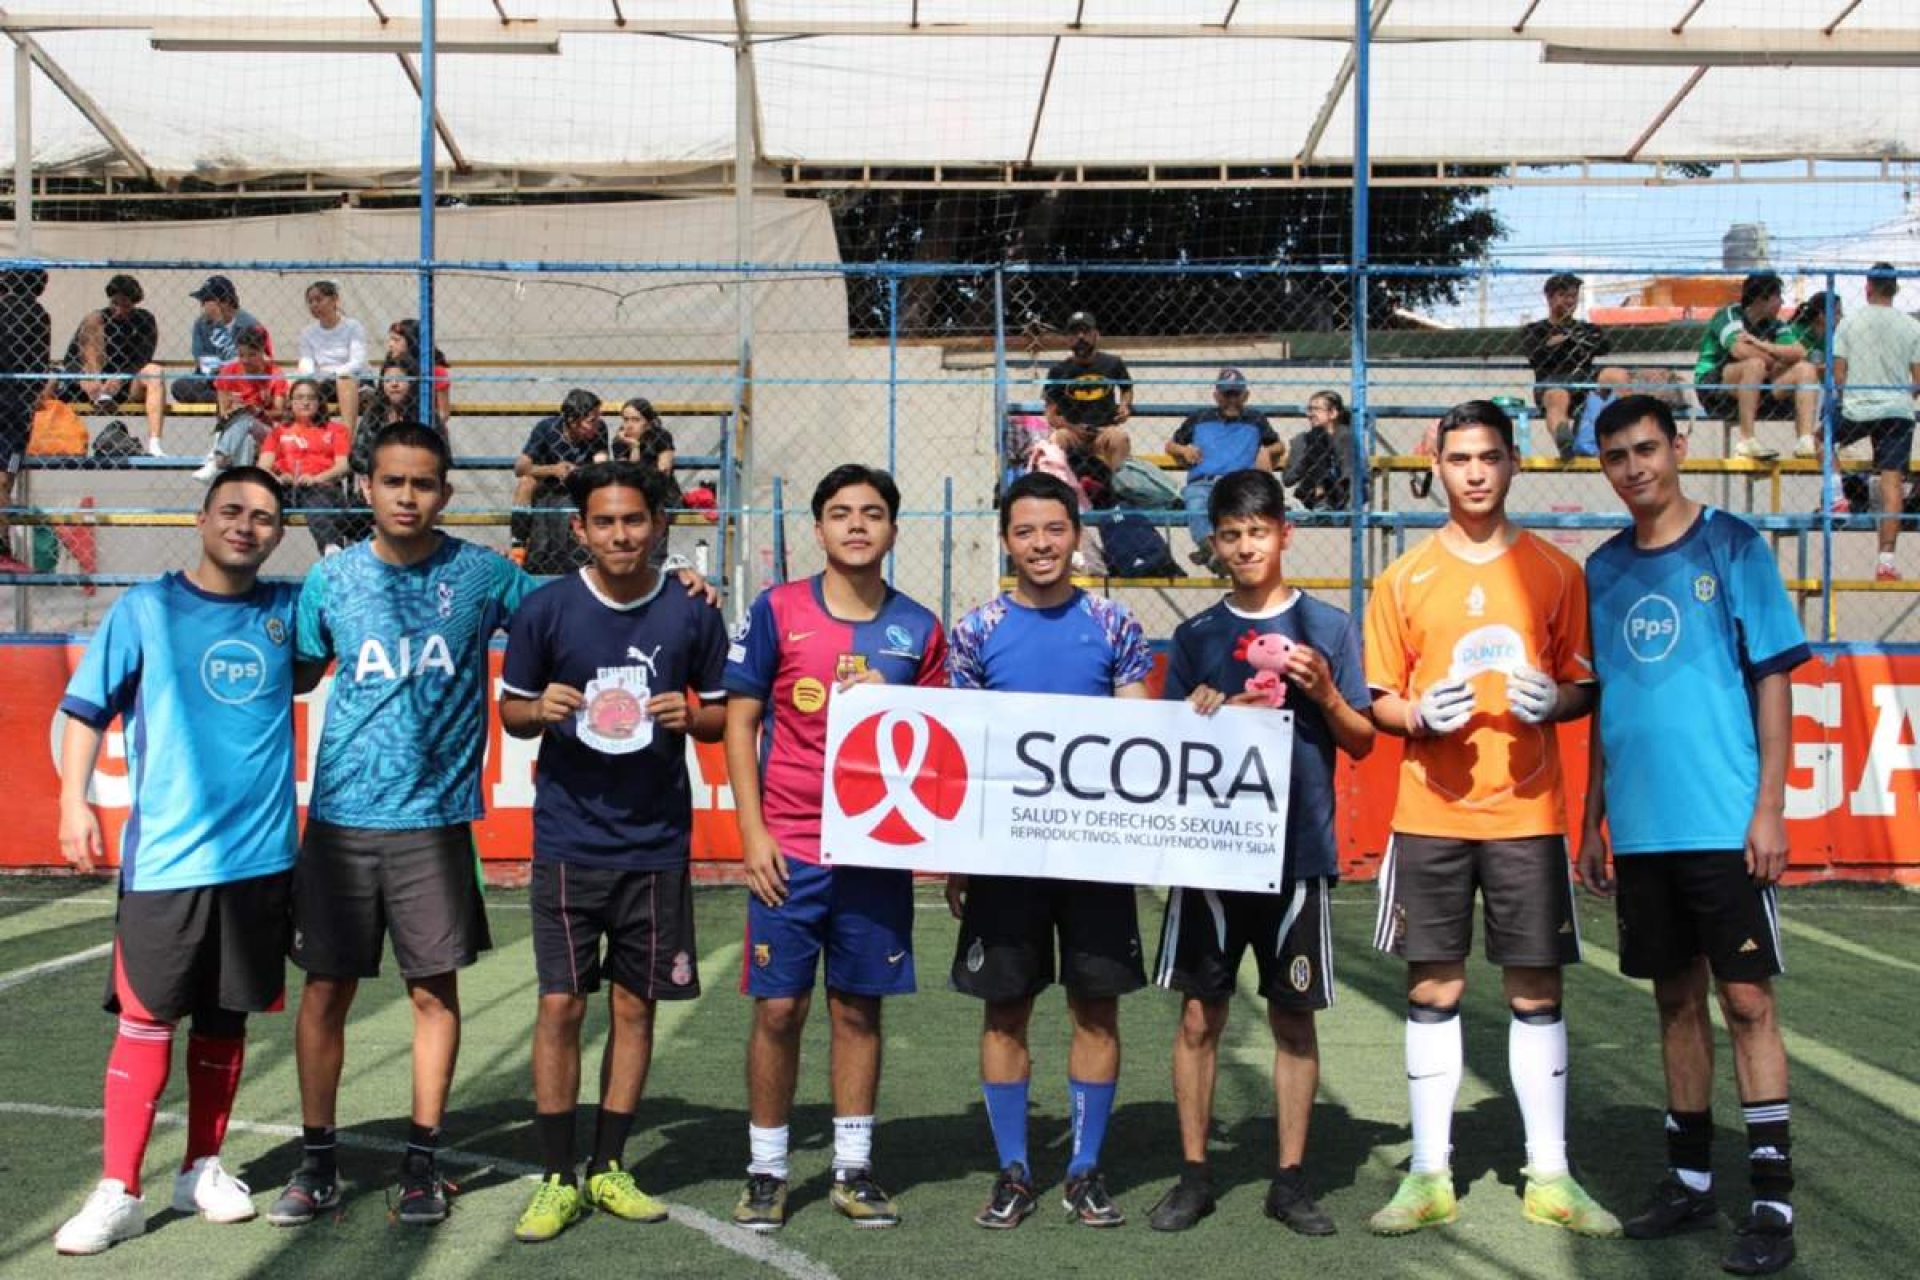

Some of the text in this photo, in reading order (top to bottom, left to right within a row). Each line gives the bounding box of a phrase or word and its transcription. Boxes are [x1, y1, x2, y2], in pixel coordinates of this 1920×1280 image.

[1631, 618, 1673, 641] Pps
[210, 660, 258, 684] Pps
[355, 634, 455, 682] AIA
[1013, 731, 1278, 813] SCORA
[1011, 806, 1278, 838] SALUD Y DERECHOS SEXUALES Y
[1124, 832, 1209, 850] INCLUYENDO
[1210, 838, 1233, 852] VIH
[1234, 840, 1244, 853] Y
[1245, 841, 1276, 855] SIDA
